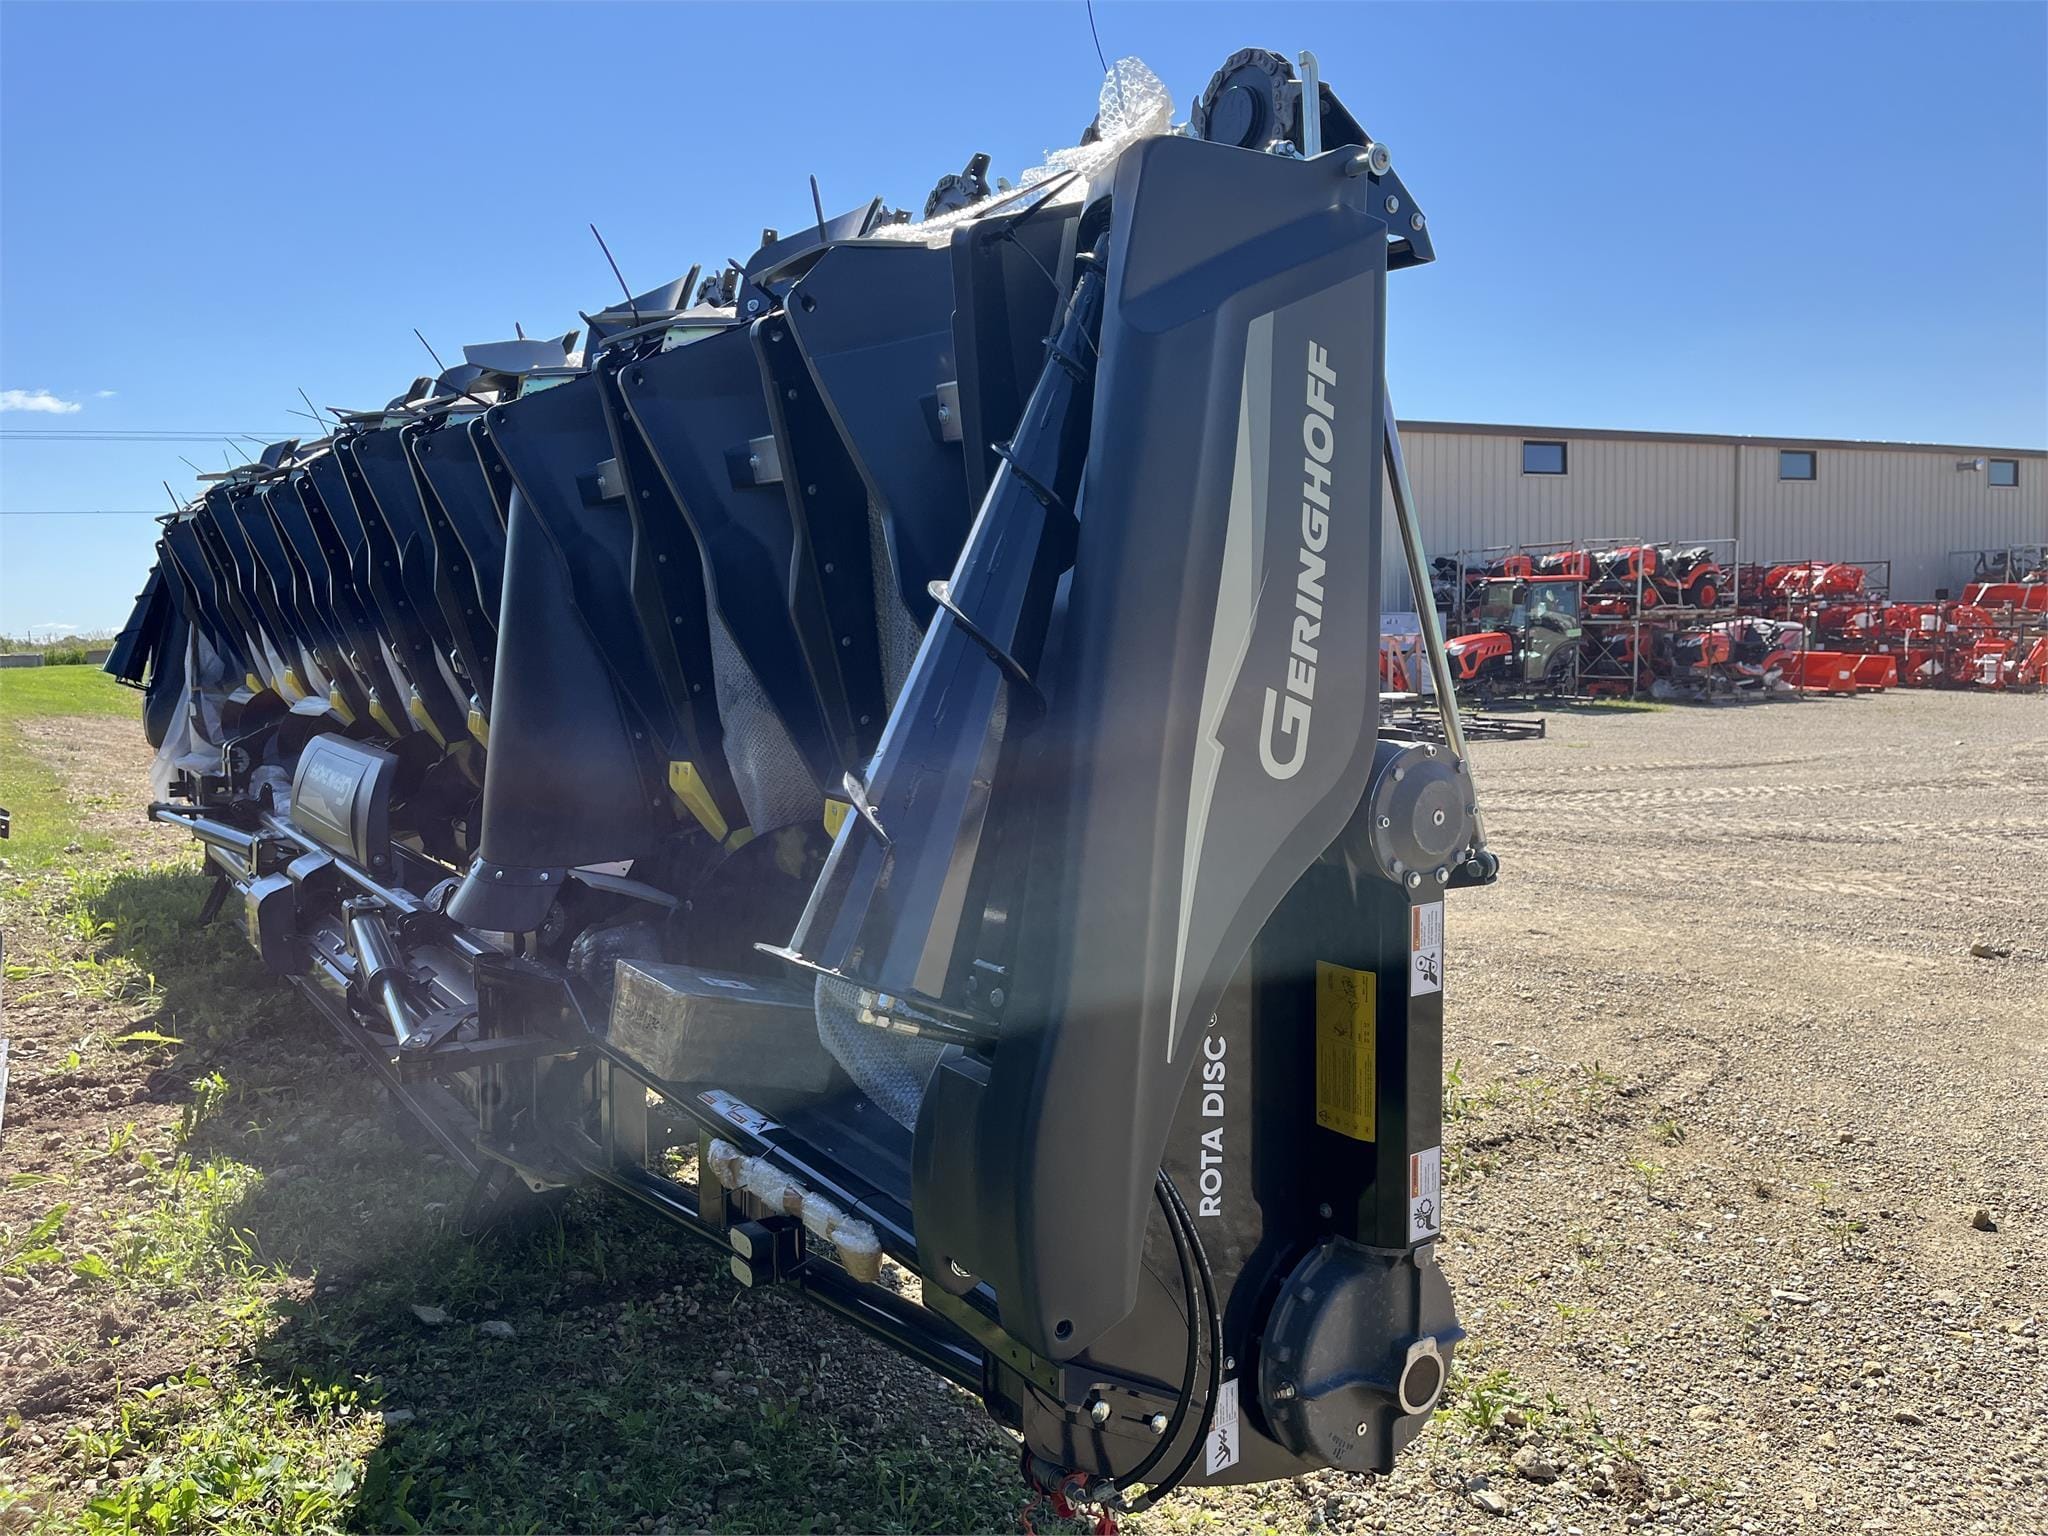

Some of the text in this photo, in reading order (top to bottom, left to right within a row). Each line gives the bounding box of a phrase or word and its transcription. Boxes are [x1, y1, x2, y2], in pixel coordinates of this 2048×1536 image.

[1259, 339, 1337, 780] GERINGHOFF
[1199, 1035, 1227, 1217] ROTA DISC
